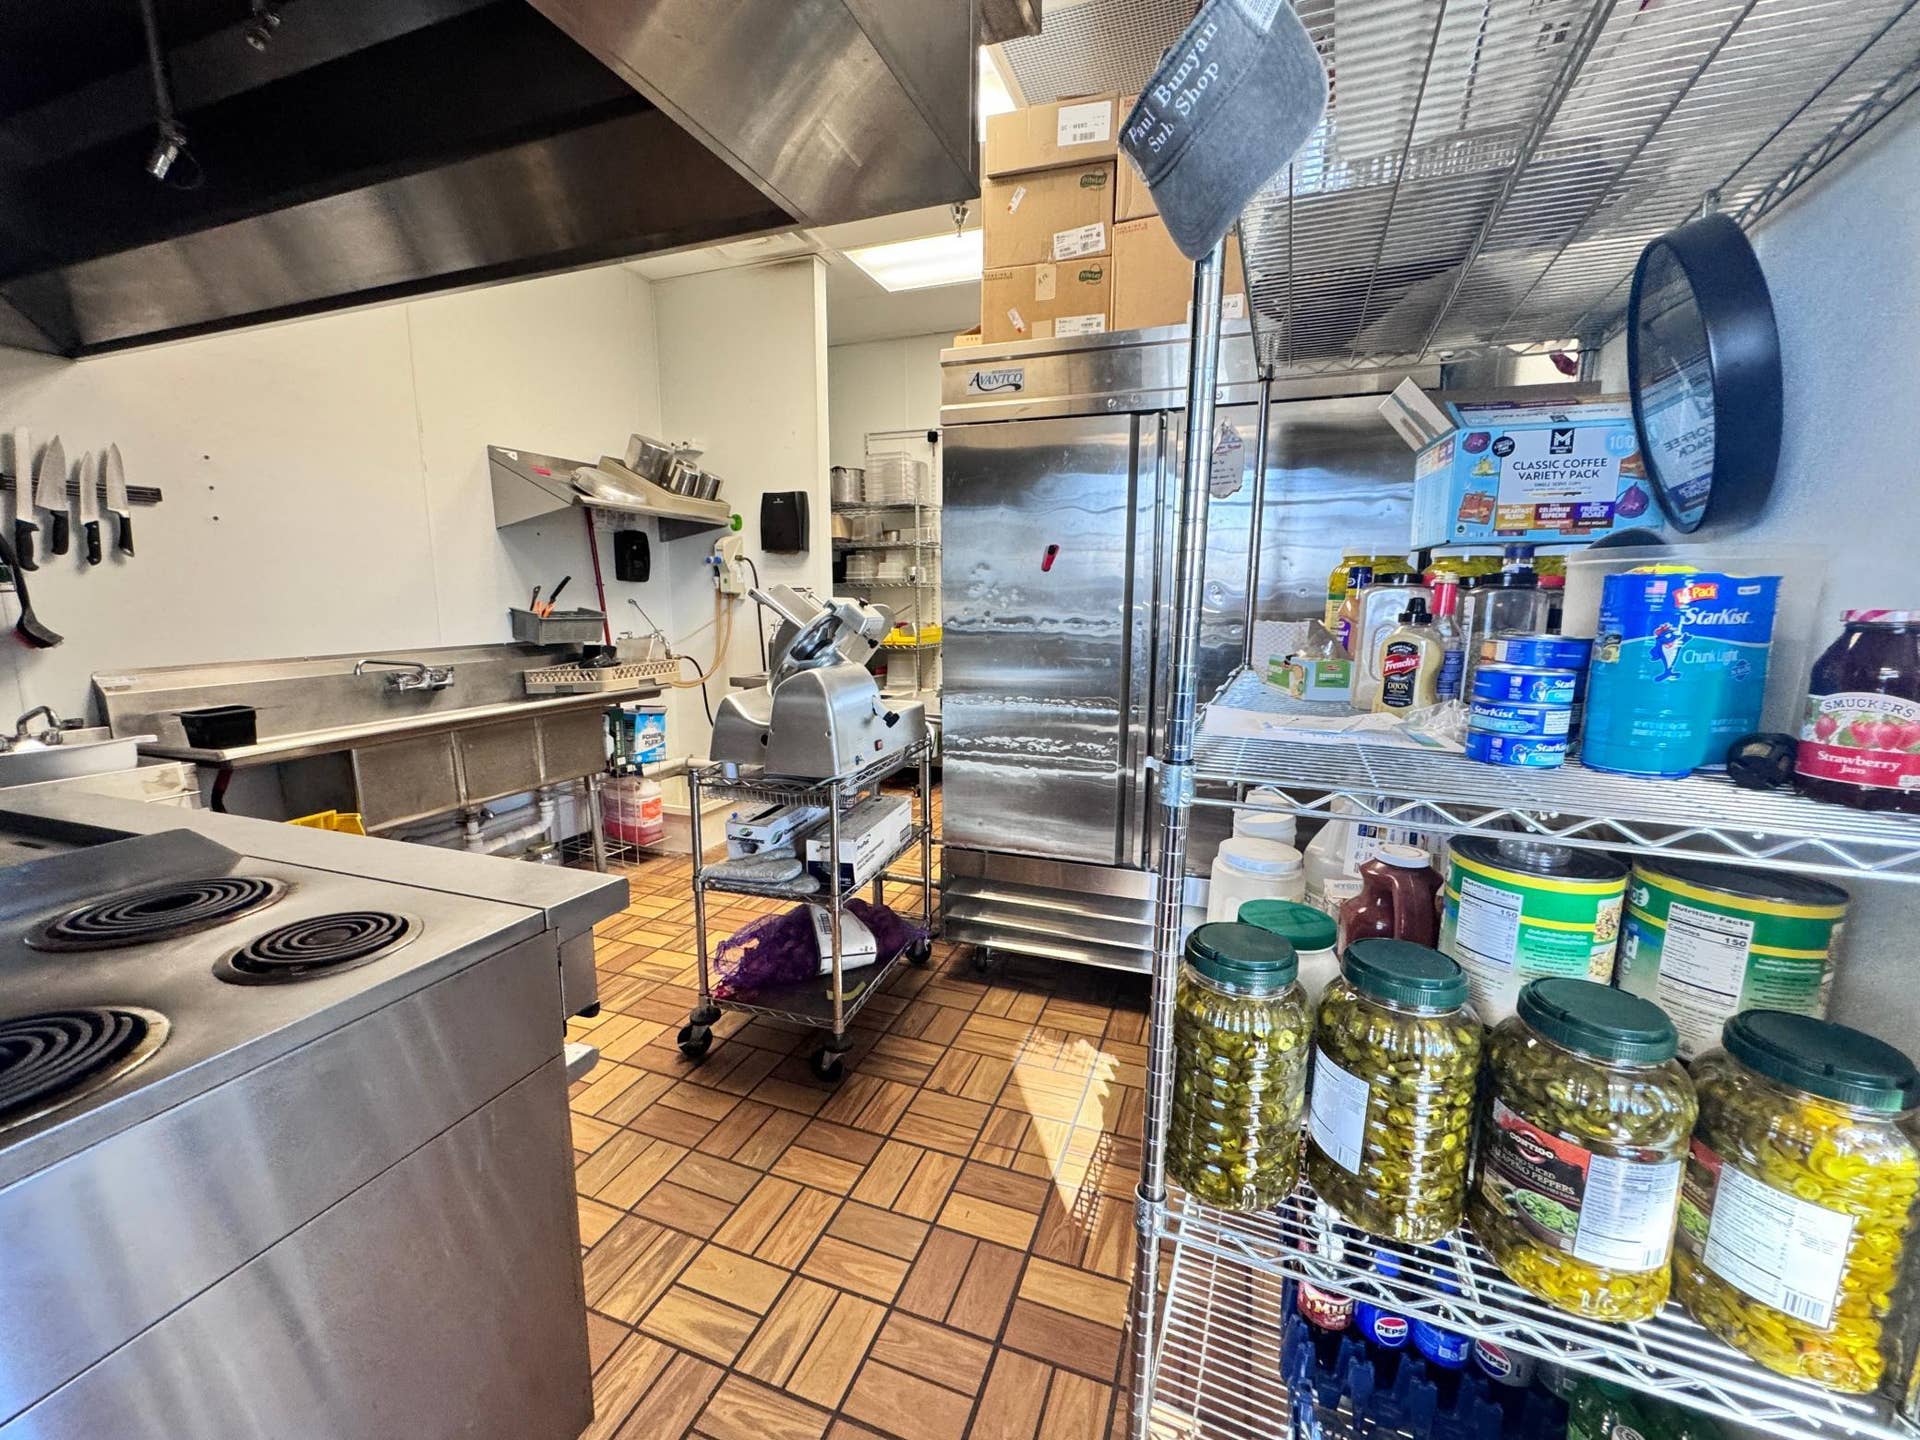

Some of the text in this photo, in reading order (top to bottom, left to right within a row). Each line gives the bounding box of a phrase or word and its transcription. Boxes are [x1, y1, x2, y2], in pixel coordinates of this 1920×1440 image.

[1128, 22, 1218, 145] Paul Bunyan
[1148, 62, 1219, 153] Sub Shop
[969, 372, 1022, 390] AVANTCO
[1512, 458, 1608, 471] CLASSIC COFFEE
[1518, 469, 1600, 481] VARIETY PACK
[1681, 607, 1750, 625] StarKist
[1474, 705, 1514, 719] StarKist
[1824, 698, 1916, 719] SMUCKER'S
[1817, 750, 1902, 772] Strawberry
[1839, 764, 1867, 775] Jam
[1672, 904, 1750, 927] Nutrition Facts
[1725, 938, 1747, 947] 150
[1531, 1172, 1575, 1195] PEPPERS
[1377, 1325, 1406, 1334] PEPSI
